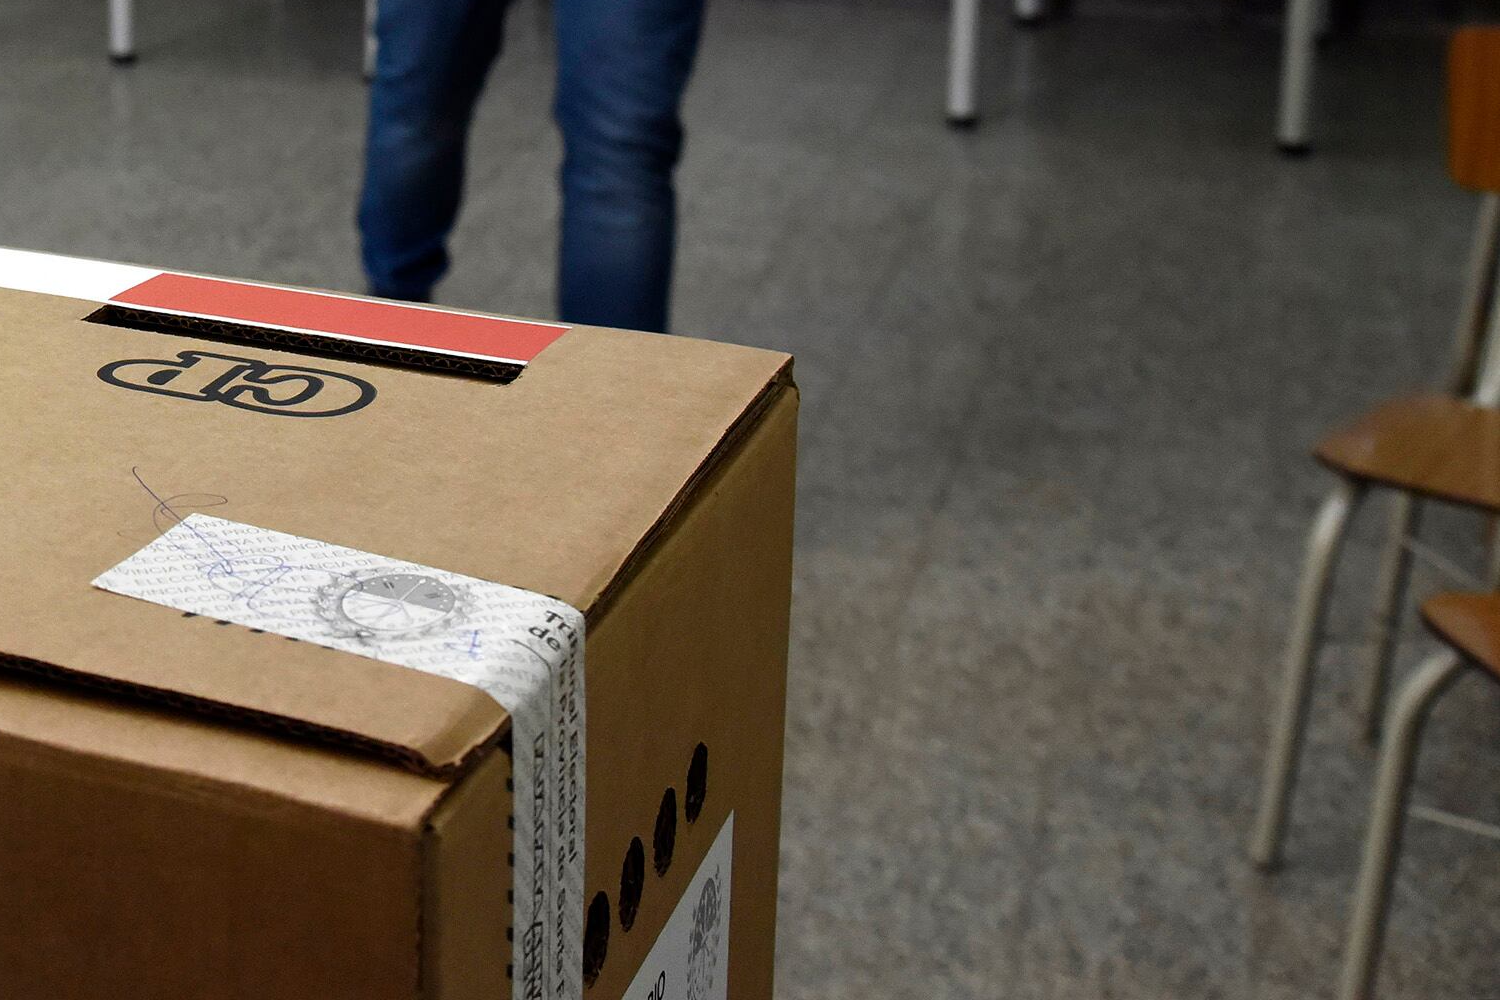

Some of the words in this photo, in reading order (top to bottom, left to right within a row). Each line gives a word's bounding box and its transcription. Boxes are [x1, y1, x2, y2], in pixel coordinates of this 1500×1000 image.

[529, 625, 561, 653] de
[558, 692, 568, 838] Provincia
[568, 729, 579, 863] Electoral
[556, 887, 566, 976] Santa
